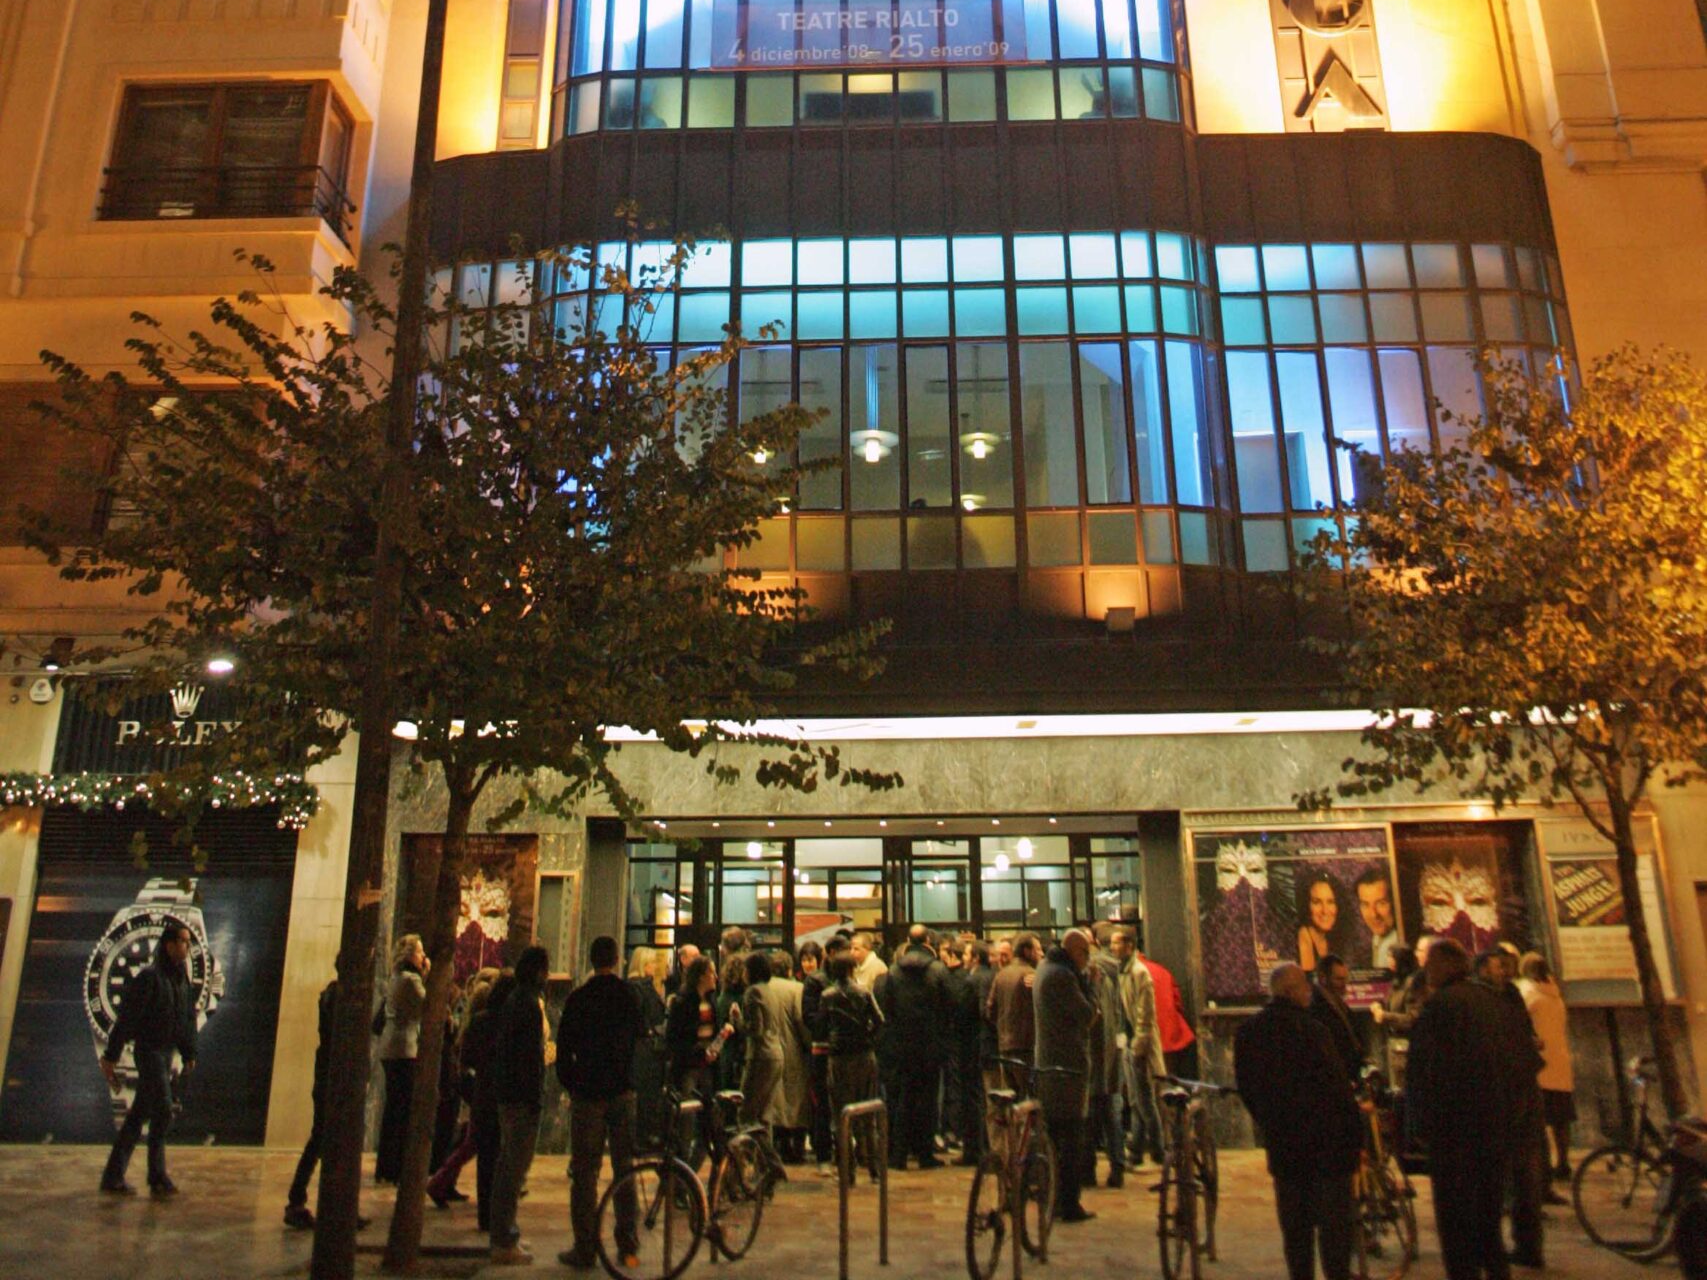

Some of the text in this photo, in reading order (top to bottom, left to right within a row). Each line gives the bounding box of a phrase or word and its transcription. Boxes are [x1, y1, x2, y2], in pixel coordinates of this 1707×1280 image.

[777, 9, 960, 31] TEATRE RIALTO
[728, 38, 746, 63] 4
[889, 34, 925, 59] 25
[1565, 878, 1617, 920] JUNGLE
